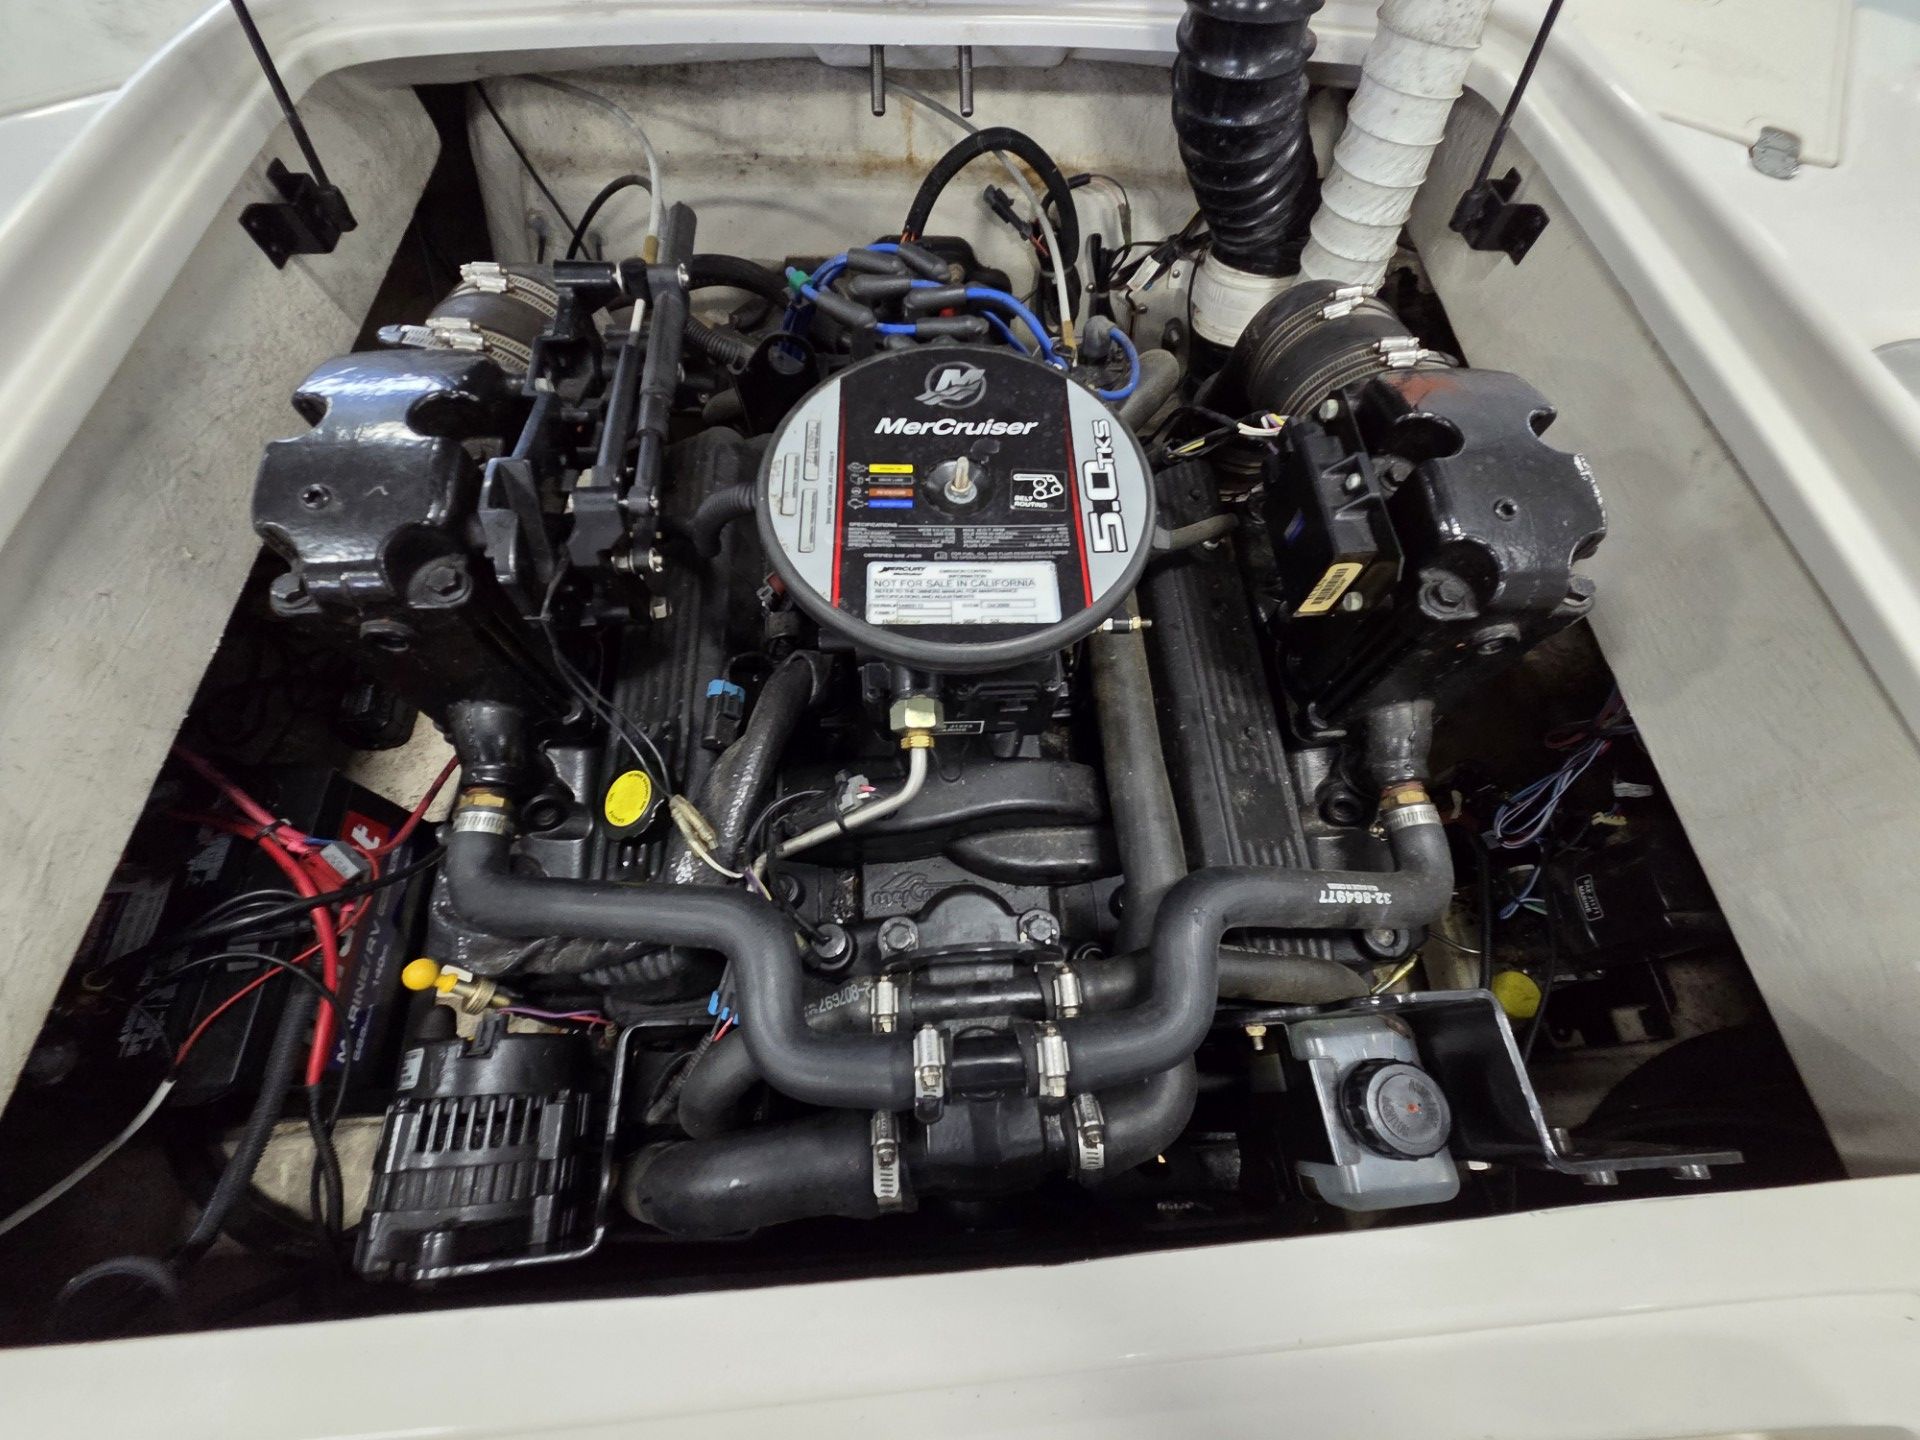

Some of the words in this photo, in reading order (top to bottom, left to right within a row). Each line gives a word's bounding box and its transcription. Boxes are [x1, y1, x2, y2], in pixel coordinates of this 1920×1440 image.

[874, 417, 1039, 436] MerCruiser
[970, 579, 1036, 587] CALIFORNIA
[1319, 890, 1393, 905] 32-864977
[336, 919, 381, 1063] MRINE/RV
